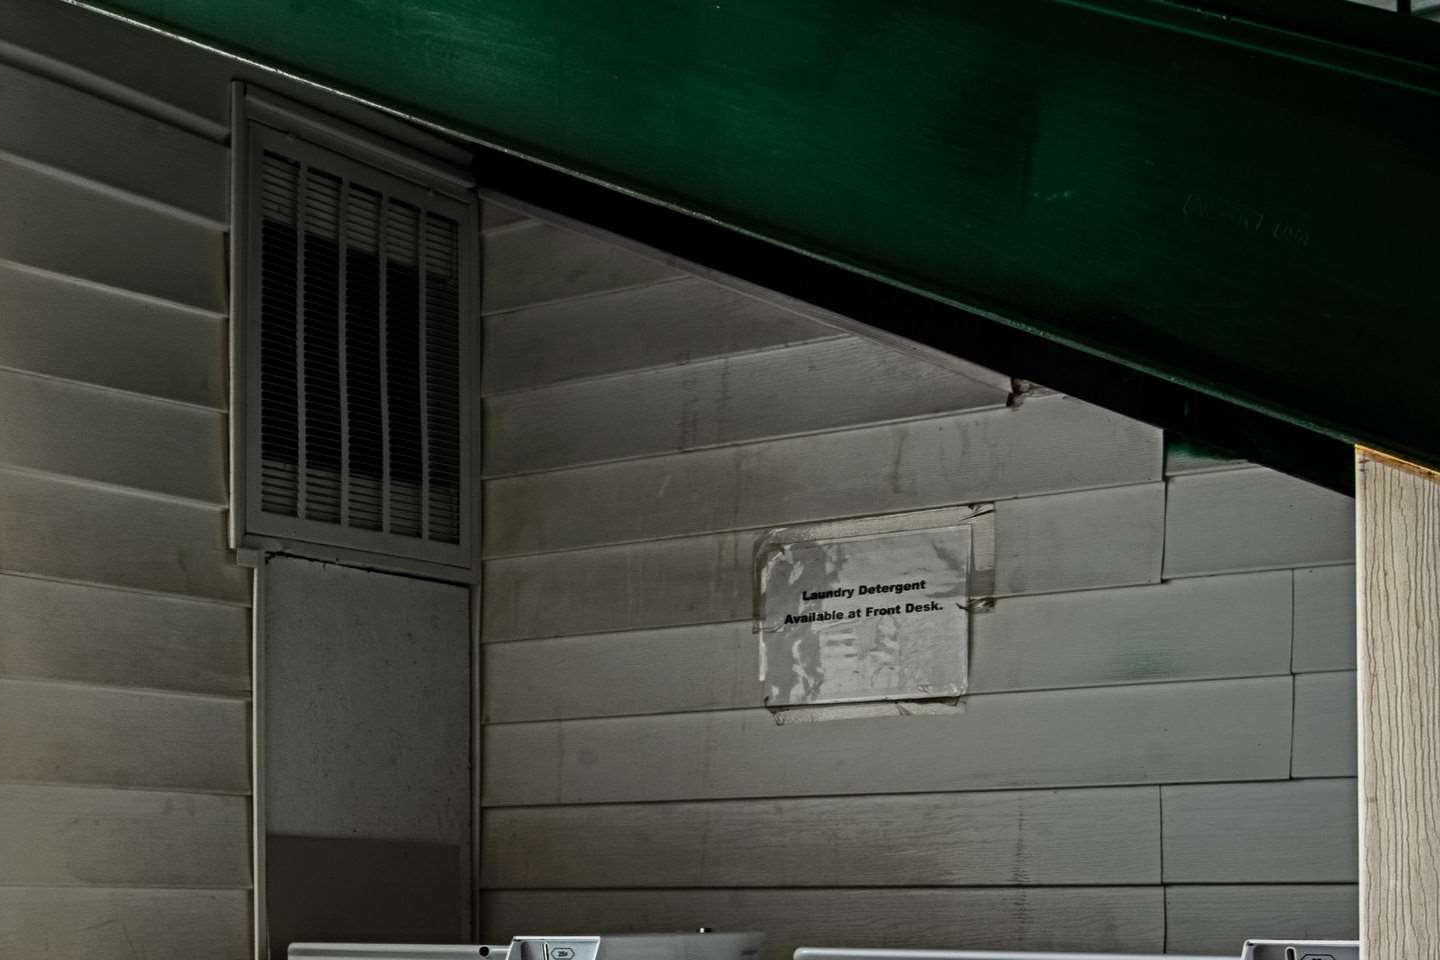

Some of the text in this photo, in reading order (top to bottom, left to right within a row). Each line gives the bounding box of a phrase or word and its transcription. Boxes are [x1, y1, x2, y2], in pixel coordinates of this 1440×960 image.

[802, 579, 926, 601] Laundry Detergent
[784, 600, 944, 625] Available at Front Desk.
